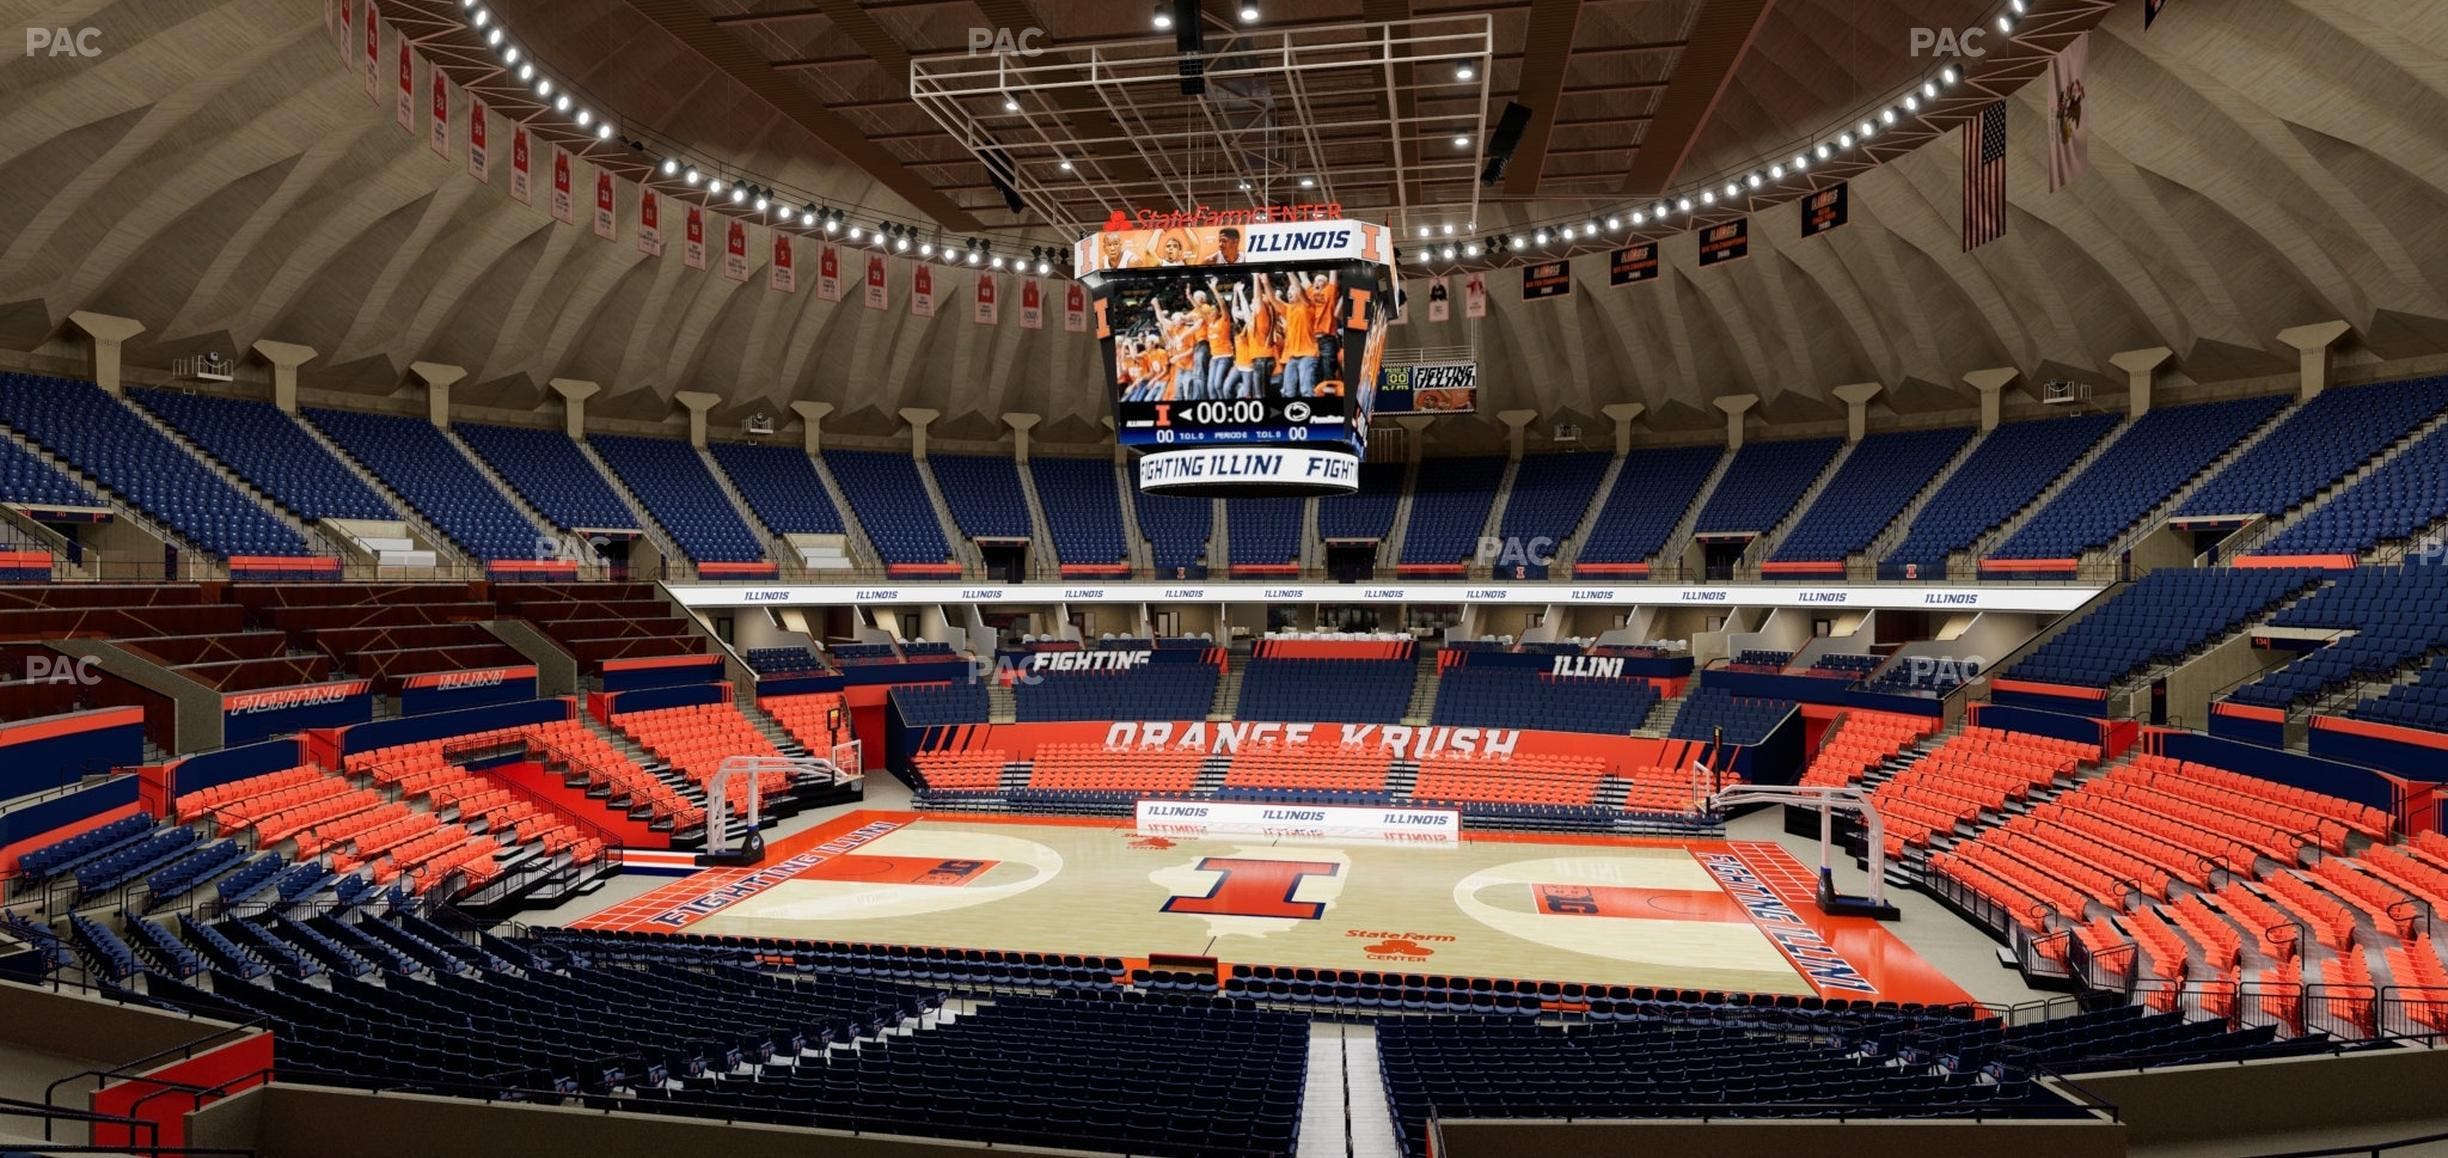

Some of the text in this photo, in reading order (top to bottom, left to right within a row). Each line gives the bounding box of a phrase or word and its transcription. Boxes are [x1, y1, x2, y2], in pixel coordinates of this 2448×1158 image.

[1248, 230, 1350, 252] ILLINOIS
[1360, 223, 1380, 261] I
[1347, 287, 1371, 331] I
[1197, 401, 1264, 424] 00:00
[1156, 429, 1174, 443] 00
[1288, 427, 1307, 441] 00
[1210, 455, 1283, 476] ILLINI
[744, 591, 790, 601] ILLINOIS
[855, 590, 898, 600] ILLINOIS
[961, 590, 1003, 599] ILLINOIS
[1064, 590, 1104, 598] ILLINOIS
[1164, 590, 1204, 598] ILLINOIS
[1263, 590, 1304, 598] ILLINOIS
[1363, 590, 1404, 598] ILLINOIS
[1466, 590, 1507, 599] ILLINOIS
[1571, 590, 1614, 599] ILLINOIS
[1682, 591, 1726, 601] ILLINOIS
[1798, 592, 1847, 602] ILLINOIS
[1924, 593, 1978, 604] ILLINOIS
[1033, 651, 1152, 671] FIGHTING
[1552, 655, 1625, 678] ILLINI
[438, 671, 504, 691] ILLINI
[230, 683, 349, 716] FIGHTING
[1103, 722, 1520, 761] ORANGE KRUSH
[1148, 805, 1208, 817] ILLINOIS
[1262, 809, 1325, 822] ILLINOIS
[1383, 813, 1449, 826] ILLINOIS
[648, 853, 823, 928] FIGHTING
[1159, 857, 1341, 920] I
[1366, 954, 1427, 962] CENTER
[1764, 924, 1880, 994] ILLINI
